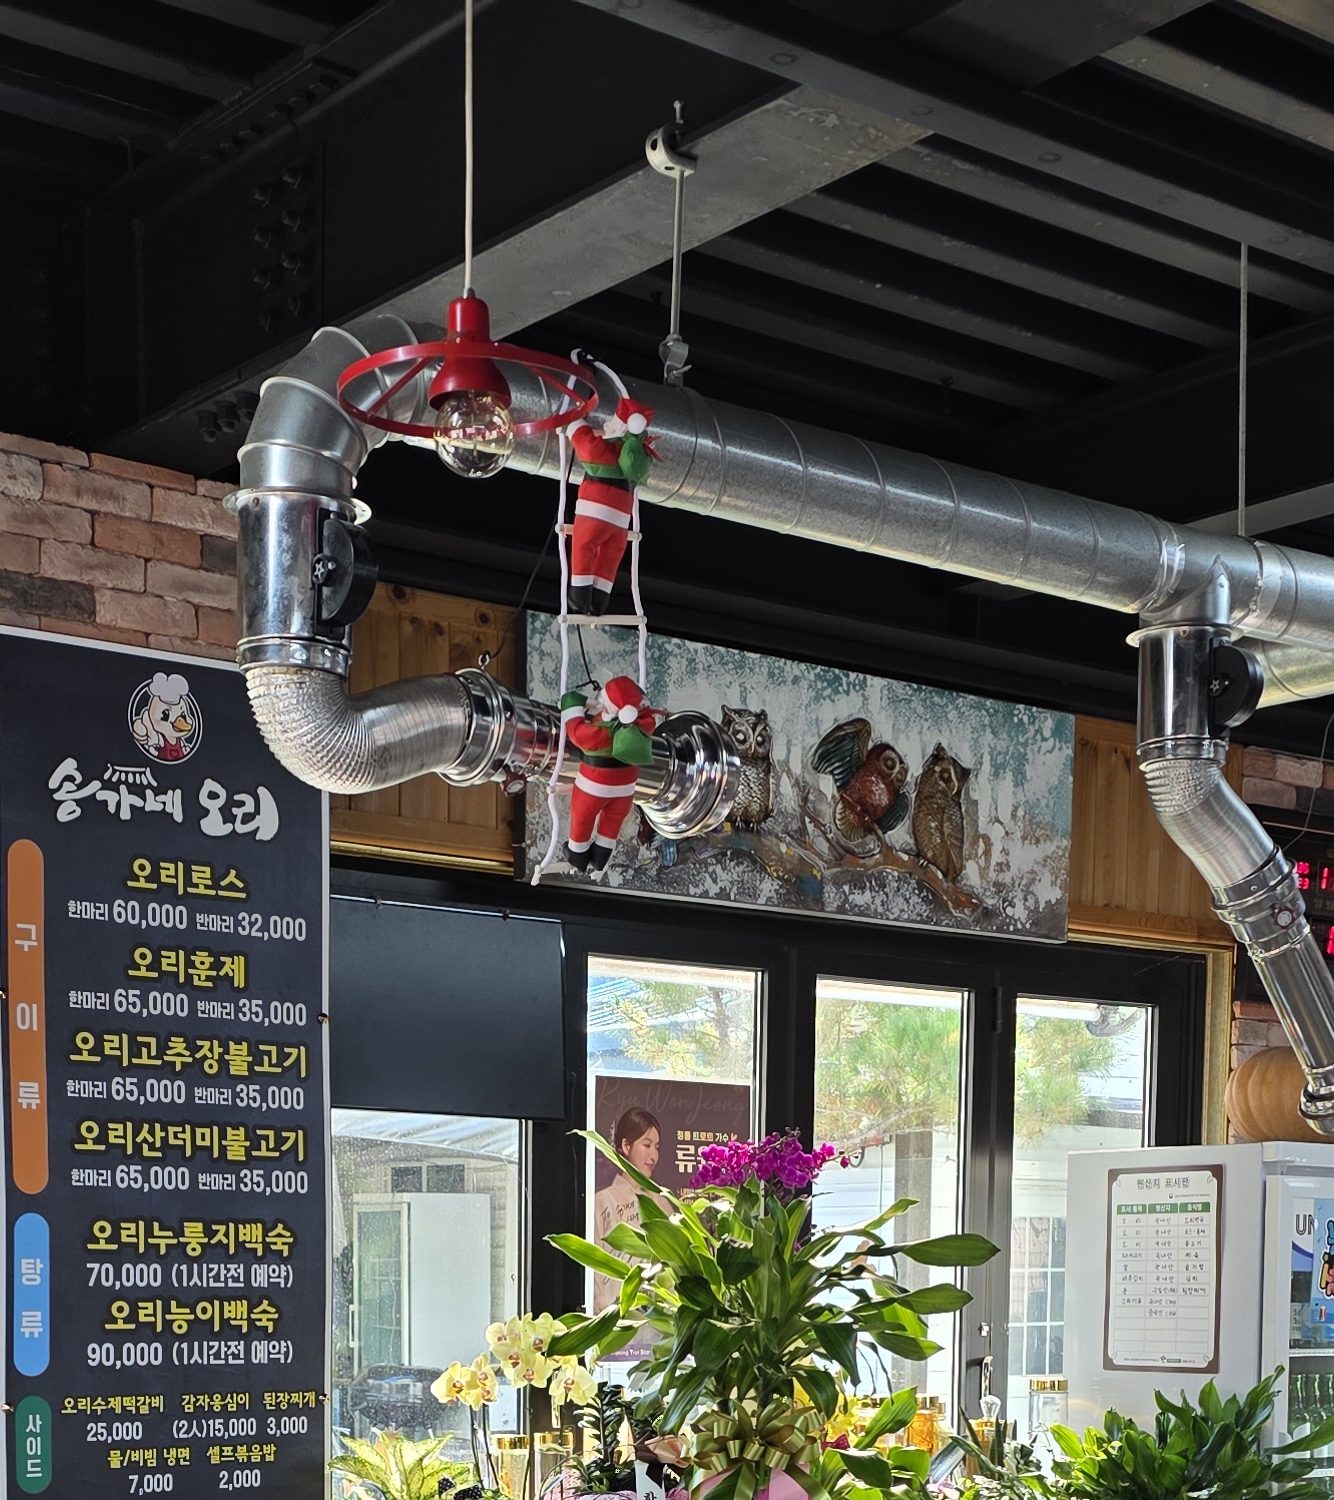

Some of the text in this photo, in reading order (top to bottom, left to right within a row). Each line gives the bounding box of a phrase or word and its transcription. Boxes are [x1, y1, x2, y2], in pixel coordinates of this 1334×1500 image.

[48, 757, 279, 841] 송가네 오리
[127, 857, 247, 899] 오리로스
[68, 899, 307, 942] 한마리 60,000 반마리 32,000
[127, 947, 246, 989] 오리훈제
[68, 988, 307, 1026] 한마리 65,000 반마리 35,000
[69, 1031, 307, 1078] 오리고추장불고기
[66, 1076, 304, 1111] 한마리 65,000 반마리 35,000
[74, 1120, 304, 1162] 오리산더미불고기
[70, 1165, 308, 1195] 한마리 65,000 반마리 35,000
[86, 1220, 294, 1257] 오리누룽지백숙
[86, 1263, 293, 1290] 70,000 (1시간전 예약)
[104, 1299, 279, 1334] 오리능이백숙
[87, 1340, 293, 1370] 90,000 (1시간전 예약)
[61, 1391, 316, 1415] 오리수제떡갈비 감자옹심이 된장찌개
[25, 1414, 42, 1479] 사이드
[86, 1422, 143, 1443] 25,000
[267, 1416, 308, 1436] 3,000
[108, 1444, 276, 1469] 물/비빔 냉면 셀프볶음밥
[128, 1469, 261, 1495] 7,000 2,000
